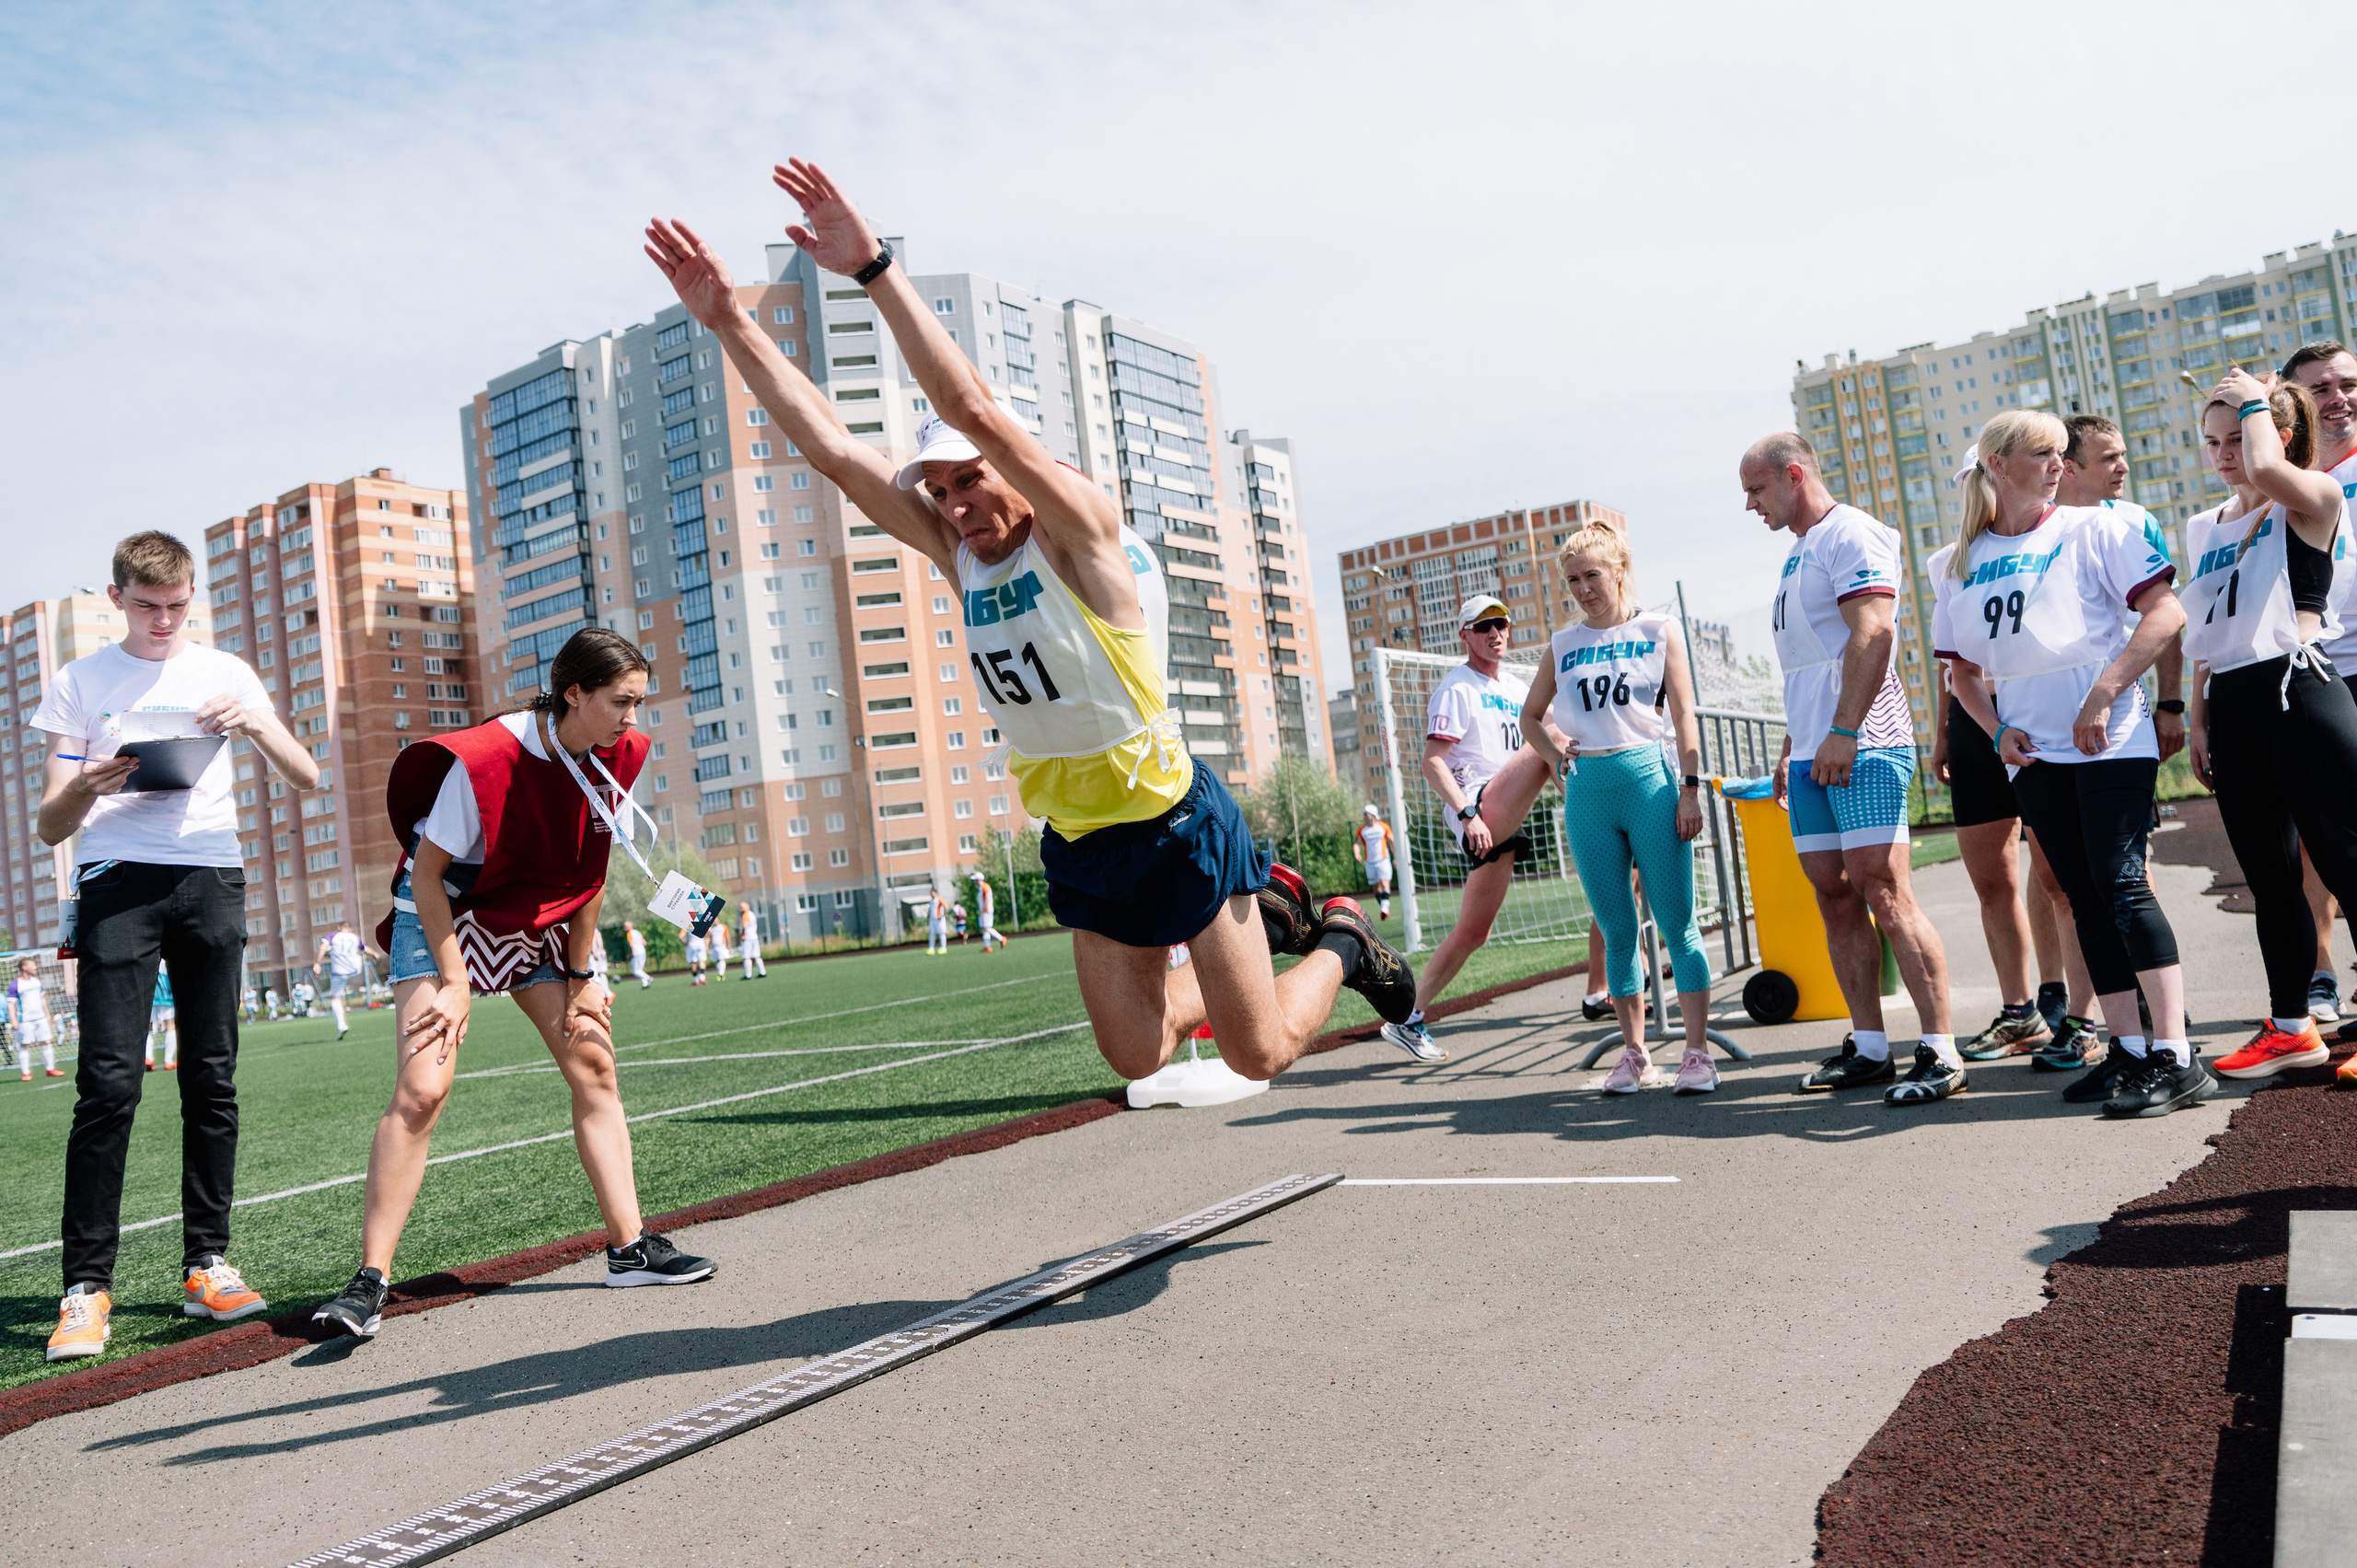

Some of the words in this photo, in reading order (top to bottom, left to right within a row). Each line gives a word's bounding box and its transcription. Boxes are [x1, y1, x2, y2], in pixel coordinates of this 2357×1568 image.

[1984, 590, 2025, 639] 99
[971, 642, 1061, 705] 151
[1561, 641, 1656, 673] СИБУР
[1577, 673, 1631, 712] 196
